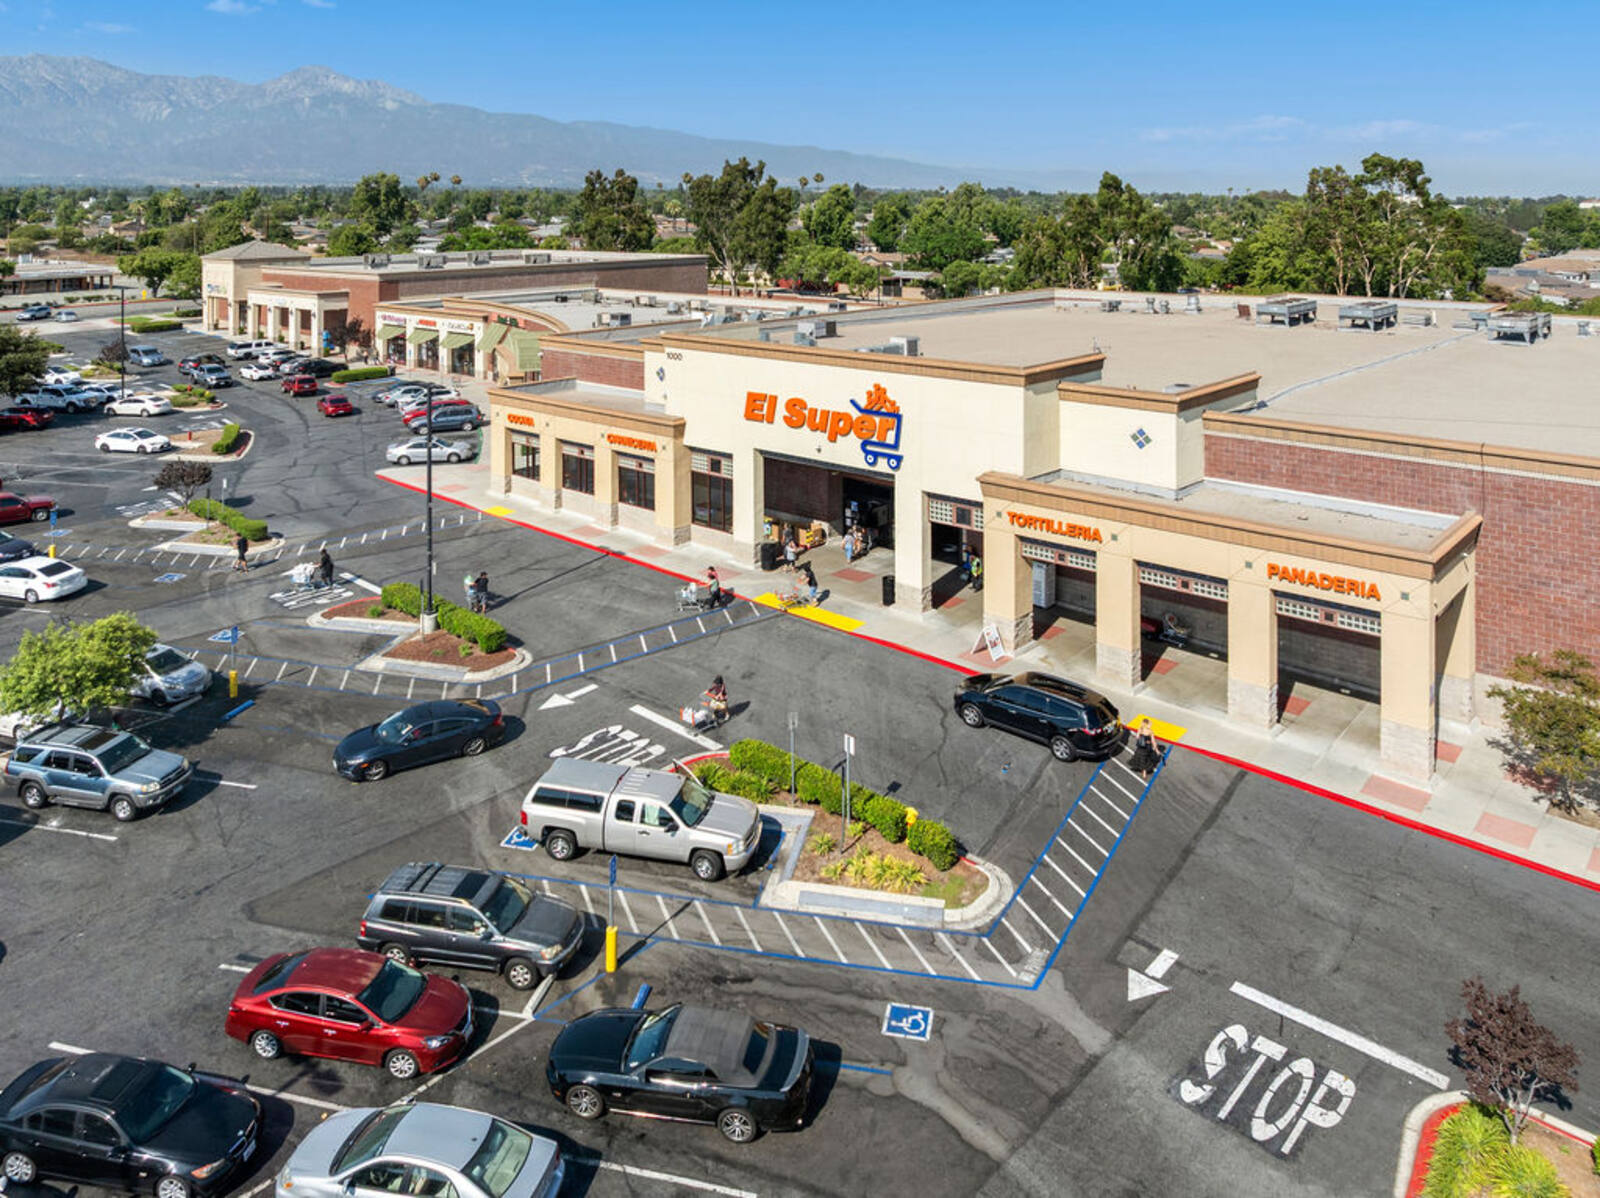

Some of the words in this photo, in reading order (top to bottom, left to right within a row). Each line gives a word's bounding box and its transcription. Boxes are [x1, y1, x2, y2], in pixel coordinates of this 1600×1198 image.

[666, 351, 684, 362] 1000
[744, 391, 778, 424] El
[782, 397, 897, 444] Super
[1007, 511, 1103, 544] TORTILLERIA
[1267, 562, 1382, 601] PANADERIA
[1180, 1024, 1357, 1155] STOP
